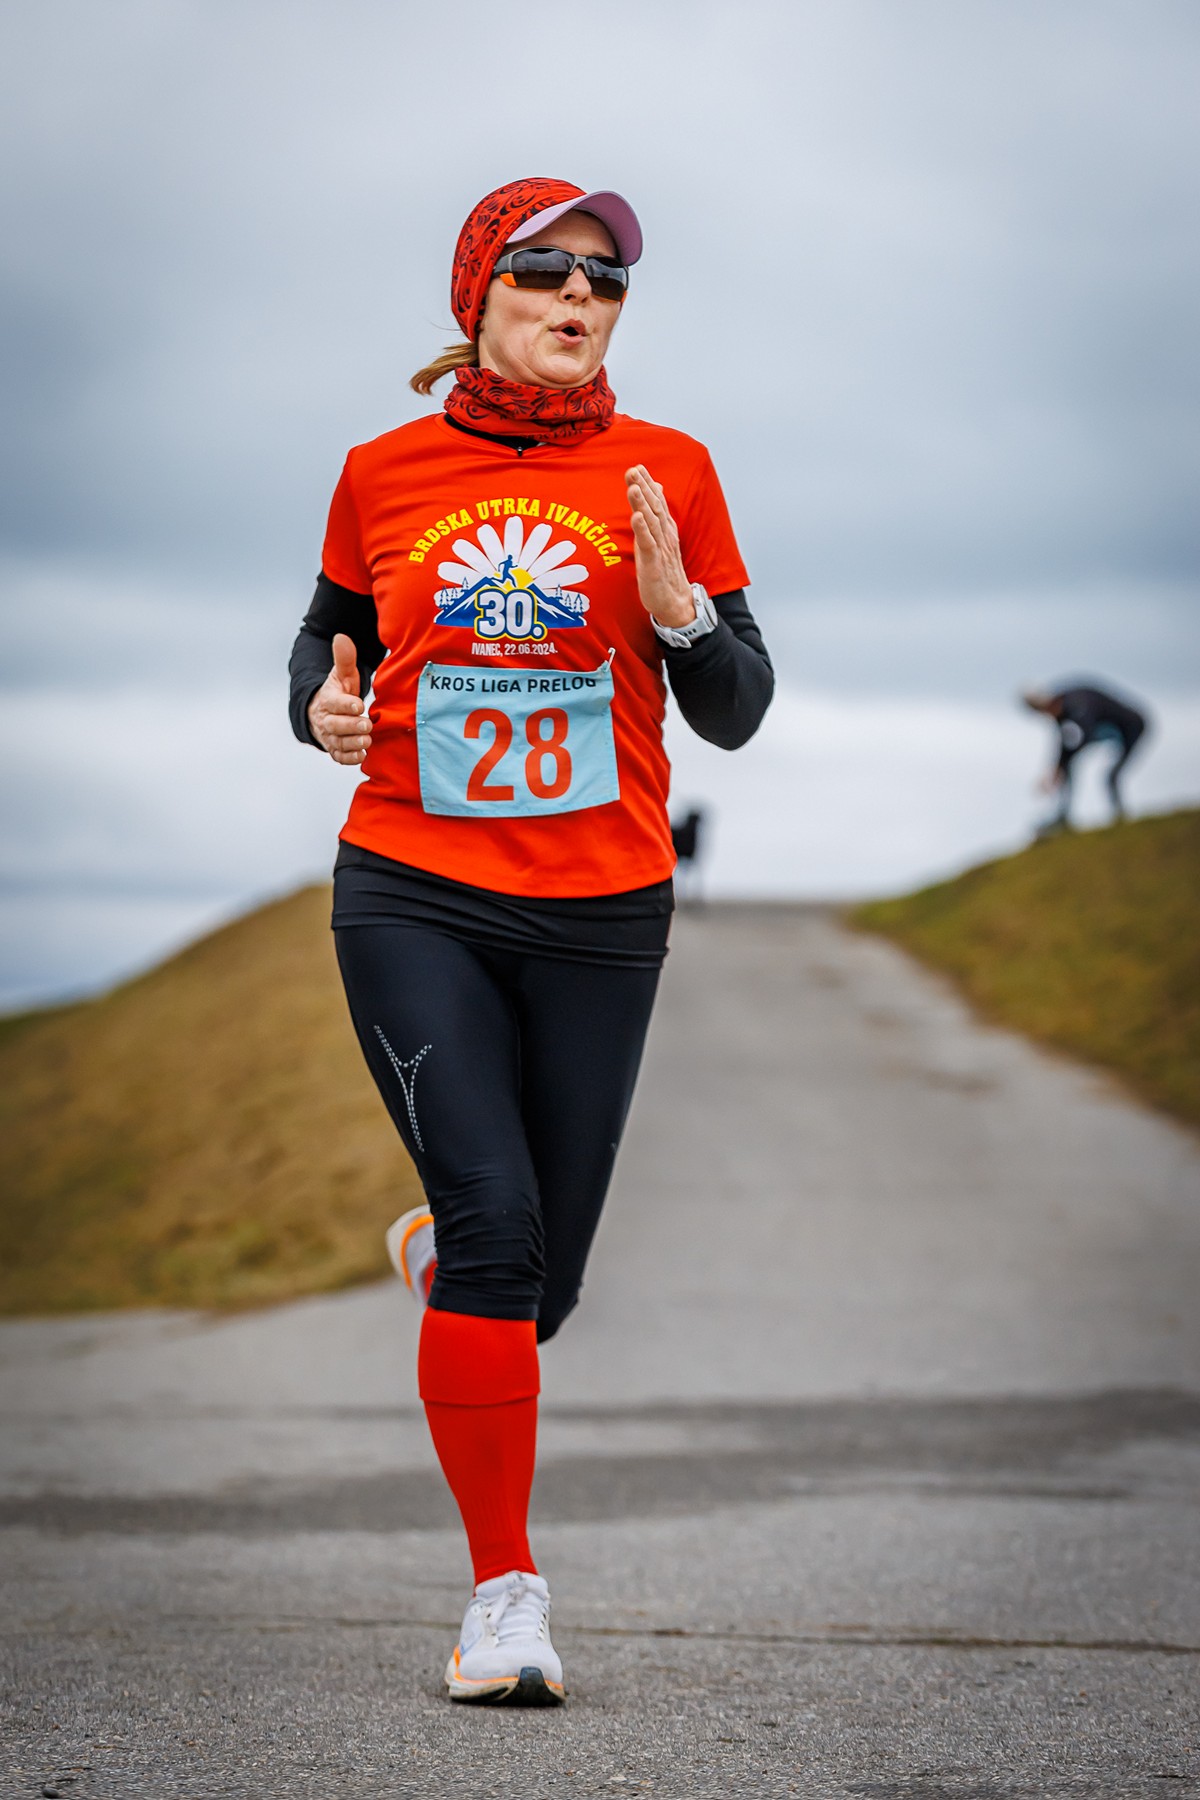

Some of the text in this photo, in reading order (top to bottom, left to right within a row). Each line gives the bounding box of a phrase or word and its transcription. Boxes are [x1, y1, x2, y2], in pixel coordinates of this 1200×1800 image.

[409, 497, 622, 566] BRDSKA UTRKA IVANČICA
[476, 588, 547, 640] 30.
[471, 642, 558, 657] IVANEC, 22.06.2024.
[430, 675, 475, 692] KROS
[481, 678, 521, 693] LIGA
[463, 707, 572, 801] 28
